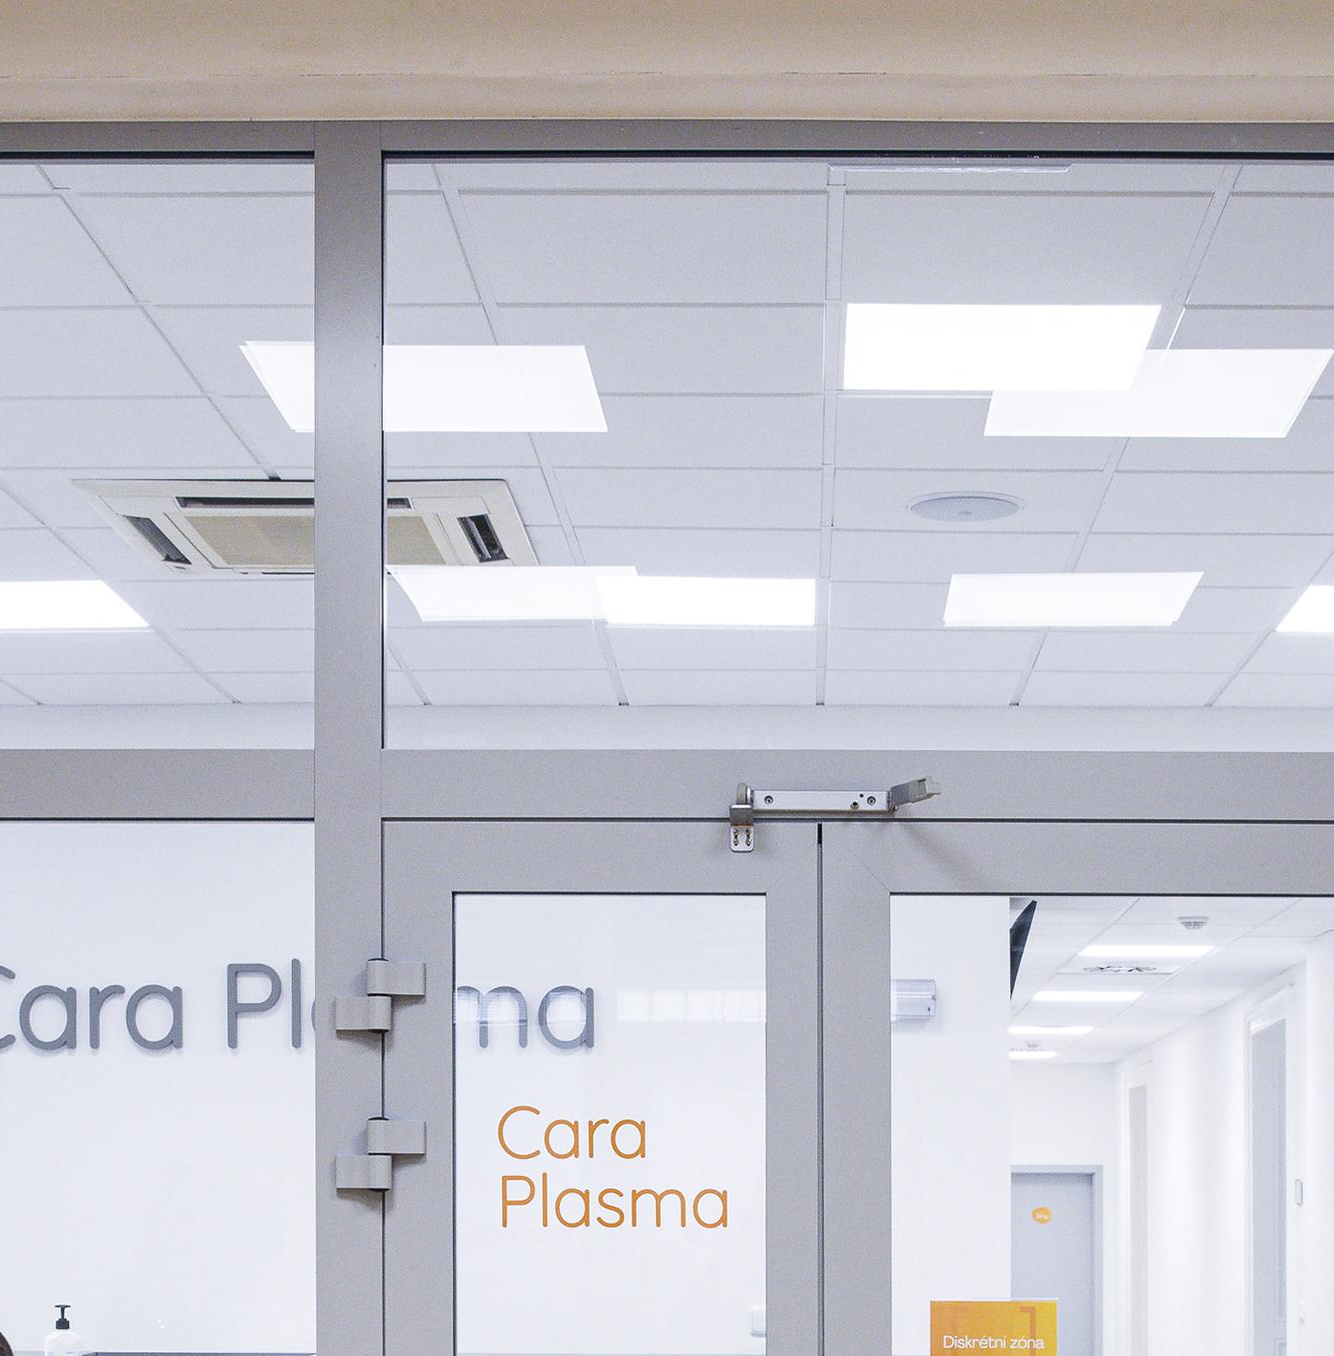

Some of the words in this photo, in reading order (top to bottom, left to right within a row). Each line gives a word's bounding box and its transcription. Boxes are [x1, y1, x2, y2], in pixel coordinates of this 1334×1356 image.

[226, 958, 595, 1050] Plma
[498, 1105, 646, 1160] Cara
[501, 1172, 728, 1229] Plasma
[943, 1335, 1006, 1349] Diskrétní
[1010, 1337, 1045, 1349] zóna
